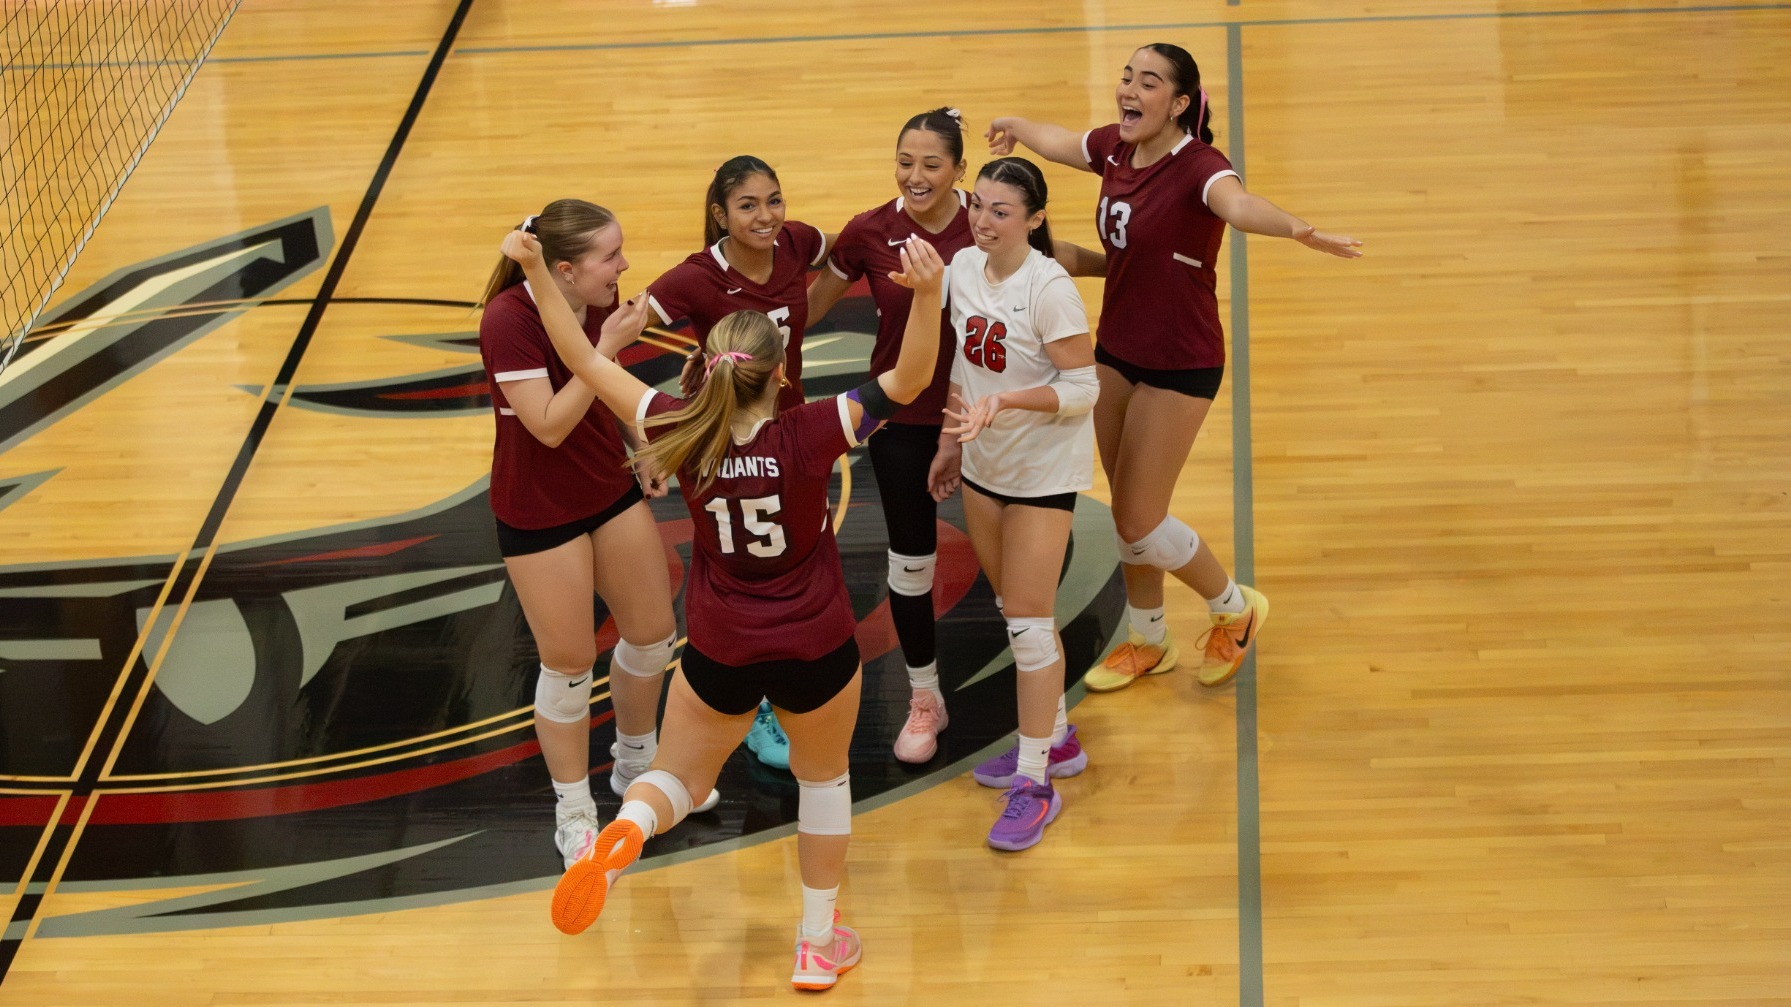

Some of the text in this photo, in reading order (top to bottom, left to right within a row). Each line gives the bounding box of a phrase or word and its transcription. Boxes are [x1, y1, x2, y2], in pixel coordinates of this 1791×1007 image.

[1099, 196, 1132, 250] 13
[963, 315, 1008, 374] 26
[704, 494, 787, 558] 15
